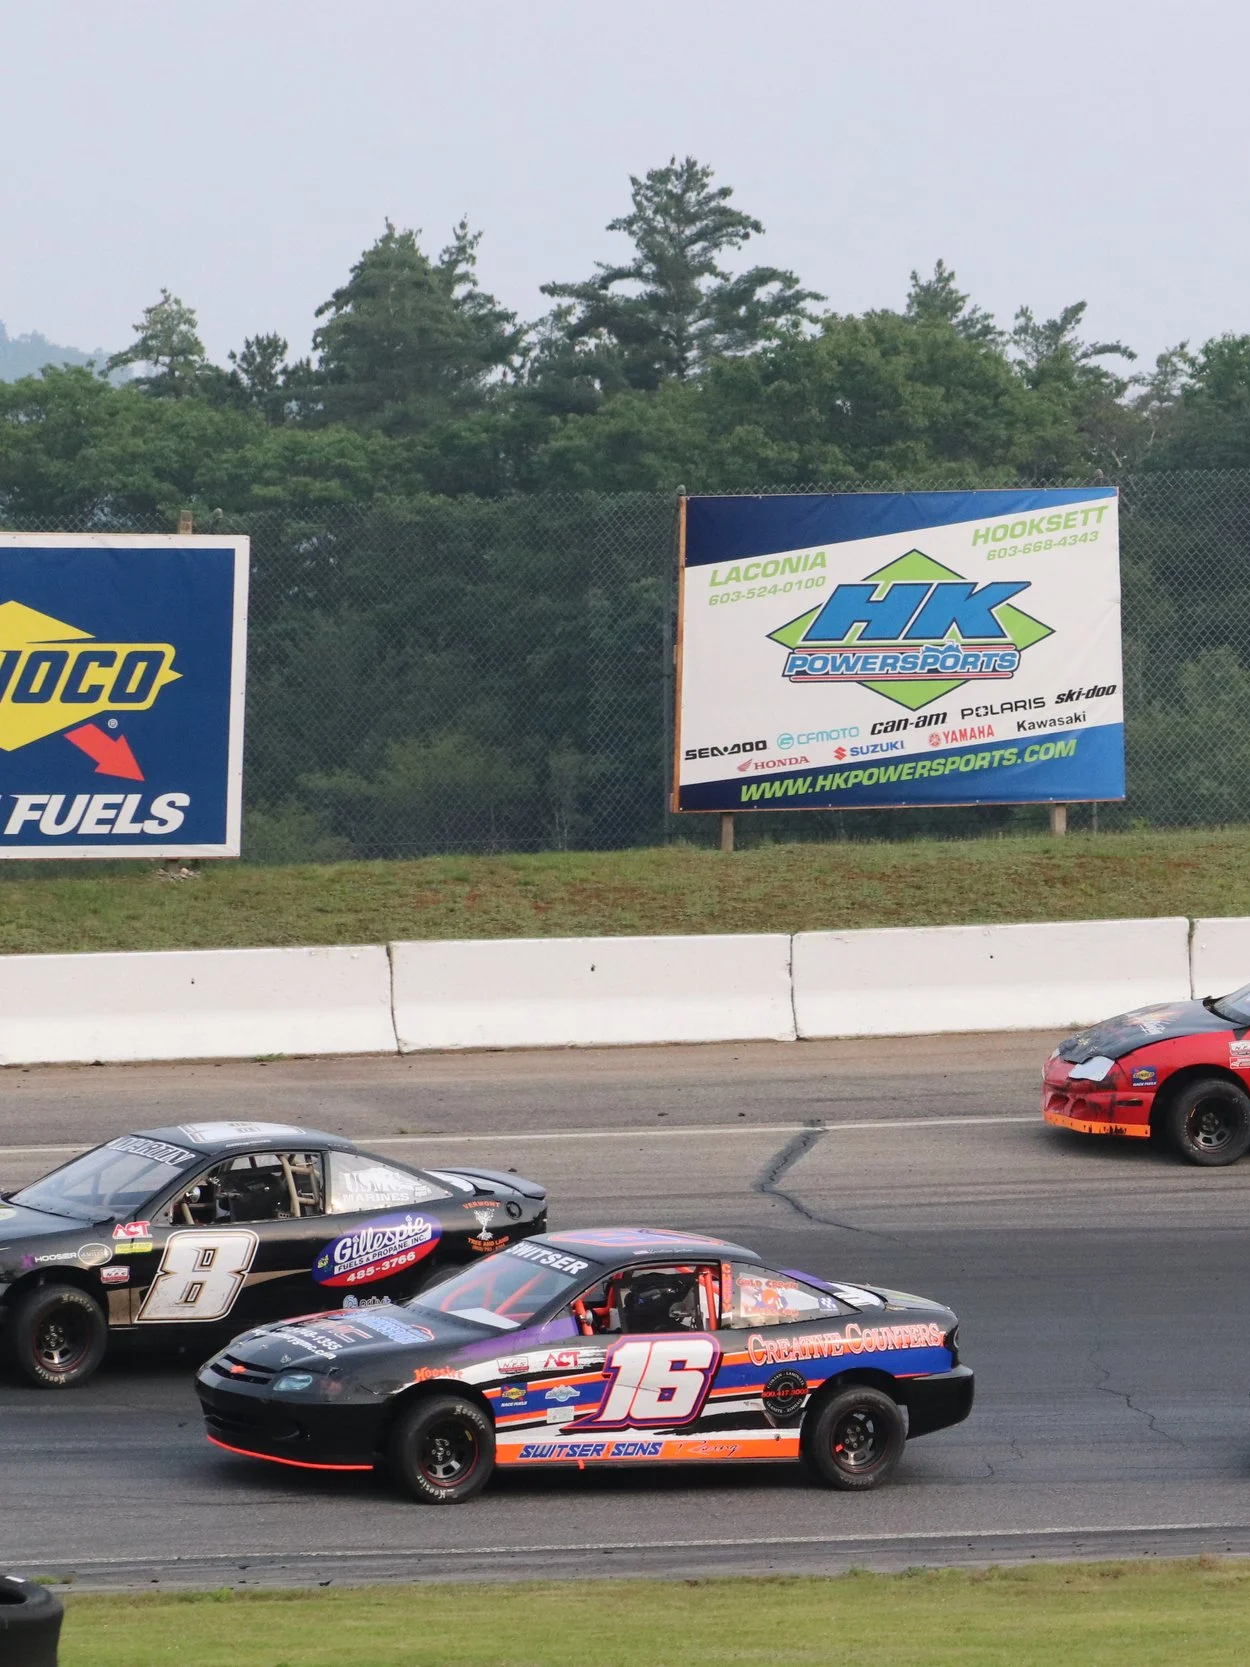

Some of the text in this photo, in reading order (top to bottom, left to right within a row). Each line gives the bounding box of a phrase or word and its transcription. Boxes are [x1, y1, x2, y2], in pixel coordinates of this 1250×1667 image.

[972, 506, 1109, 547] HOOKSETT
[986, 531, 1100, 561] 603-668-4343
[709, 552, 828, 587] LACONIA
[708, 575, 827, 606] 603-524-0100
[801, 581, 1032, 641] HK
[786, 649, 1019, 676] POWERSPORTS
[961, 697, 1046, 720] POLARIS
[1055, 684, 1118, 705] ski-doo
[797, 726, 860, 745] CFMOTO
[870, 711, 948, 736] can-am
[943, 724, 995, 745] YAMAHA
[1016, 711, 1087, 733] Kawasaki
[850, 740, 905, 757] SUZUKI
[741, 739, 1077, 802] WWW.HKPOWERSPORTS.COM
[753, 755, 811, 771] HONDA
[3, 792, 191, 836] FUELS
[462, 1200, 501, 1209] VERMONT
[334, 1216, 432, 1264] Gillespie
[338, 1258, 364, 1272] FUELS
[372, 1242, 408, 1260] PROPANE
[411, 1234, 427, 1245] INC.
[34, 1251, 78, 1263] HOOSIER
[346, 1251, 416, 1283] 485-3766
[507, 1241, 589, 1276] SWITSER
[134, 1228, 260, 1324] 8
[413, 1364, 465, 1382] Hoosier
[592, 1337, 716, 1425] 16
[519, 1441, 664, 1459] SWITSER SONS
